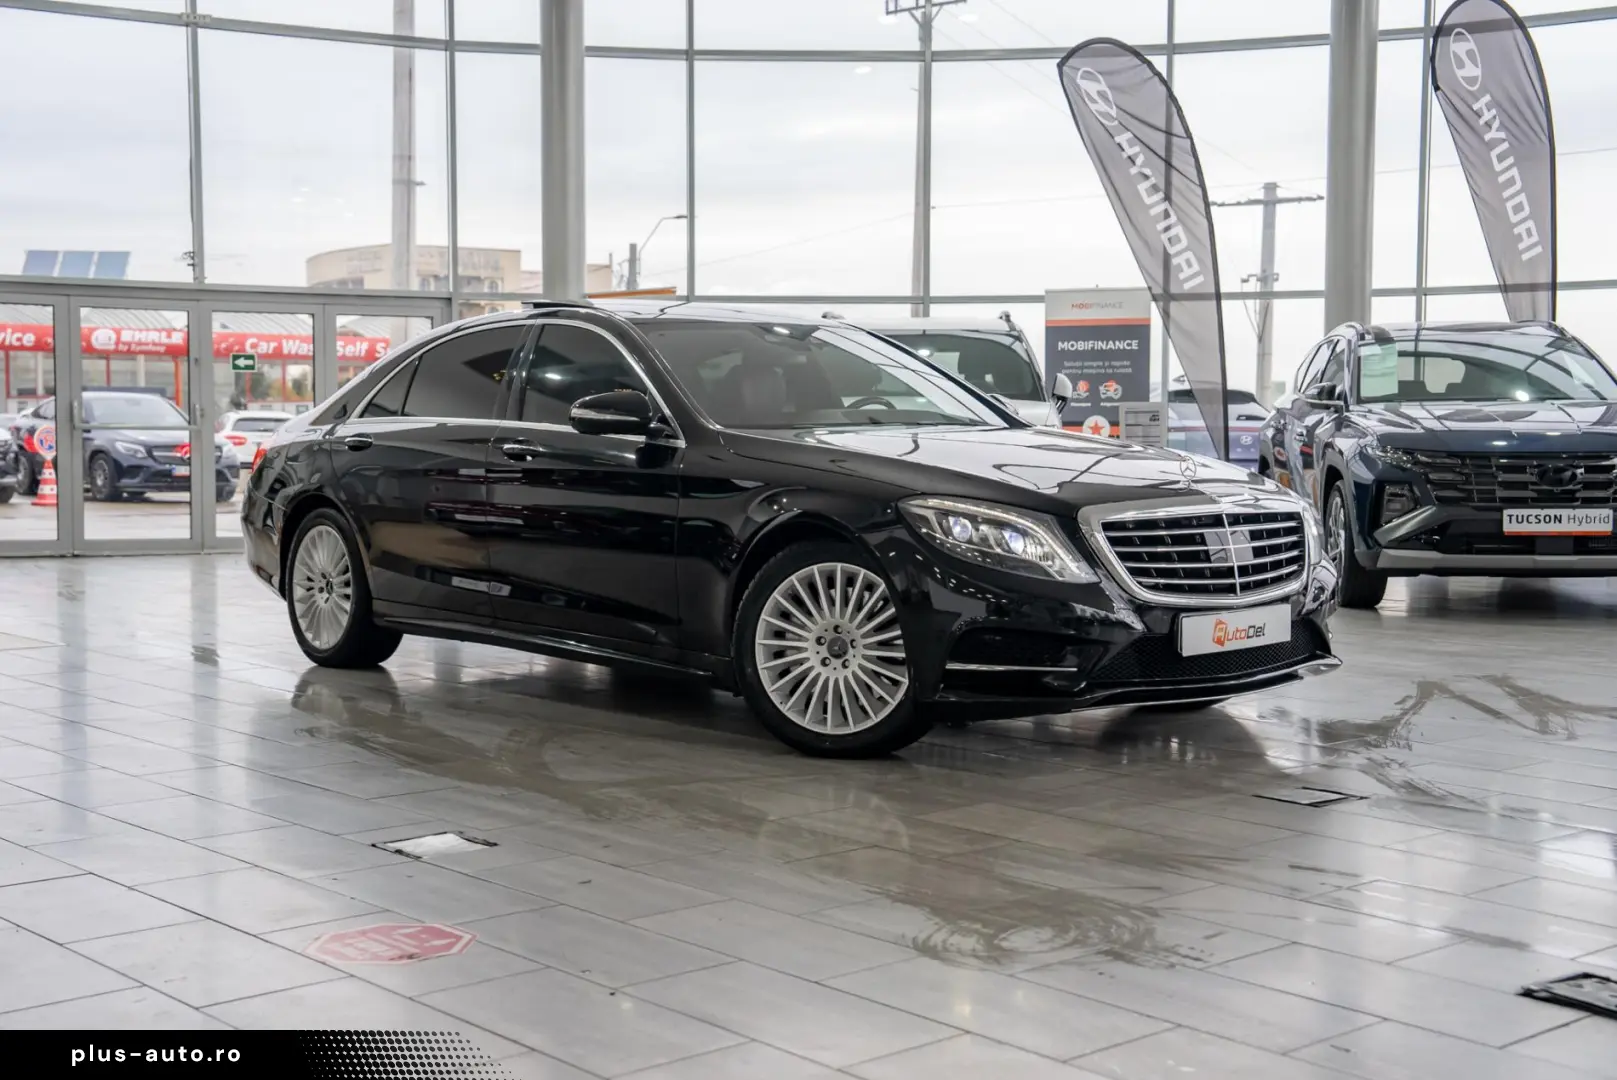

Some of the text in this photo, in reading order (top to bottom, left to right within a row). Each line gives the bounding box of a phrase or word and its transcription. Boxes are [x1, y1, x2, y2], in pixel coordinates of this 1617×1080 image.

[1472, 93, 1543, 262] HYUNDAI
[1114, 131, 1204, 290] HYUNDAI
[120, 330, 184, 344] EHRLE
[1057, 339, 1139, 351] MOBIFINANCE
[245, 338, 277, 354] Car
[282, 339, 313, 356] Was
[336, 340, 368, 357] Self
[1507, 513, 1610, 526] TUCSON Hybrid
